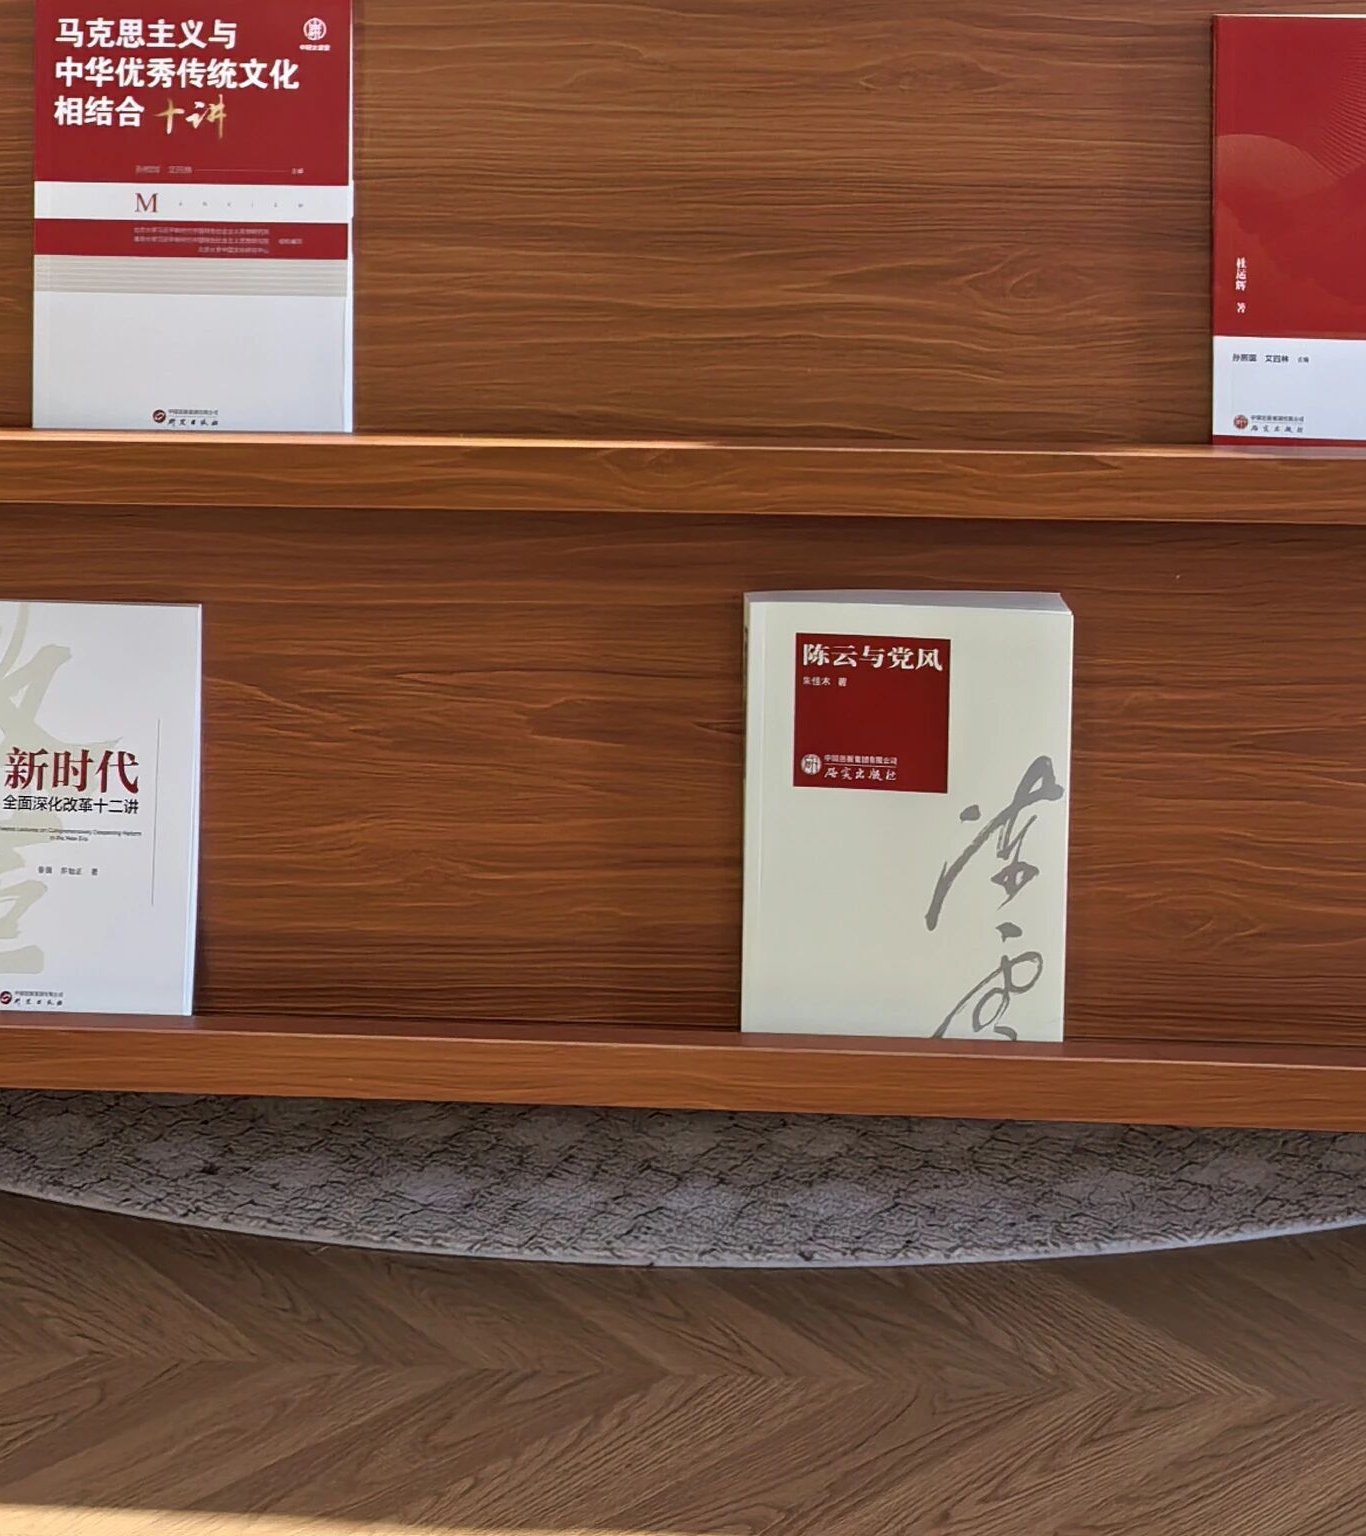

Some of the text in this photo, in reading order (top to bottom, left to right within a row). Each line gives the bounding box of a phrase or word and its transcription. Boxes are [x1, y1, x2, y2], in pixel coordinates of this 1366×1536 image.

[54, 17, 237, 51] 马克思主义与
[54, 56, 300, 90] 中华优秀传统文化
[54, 95, 145, 128] 相结合
[802, 643, 943, 672] 陈云与党风
[3, 747, 140, 794] 新时代
[2, 794, 140, 816] 全面深化改革十二讲
